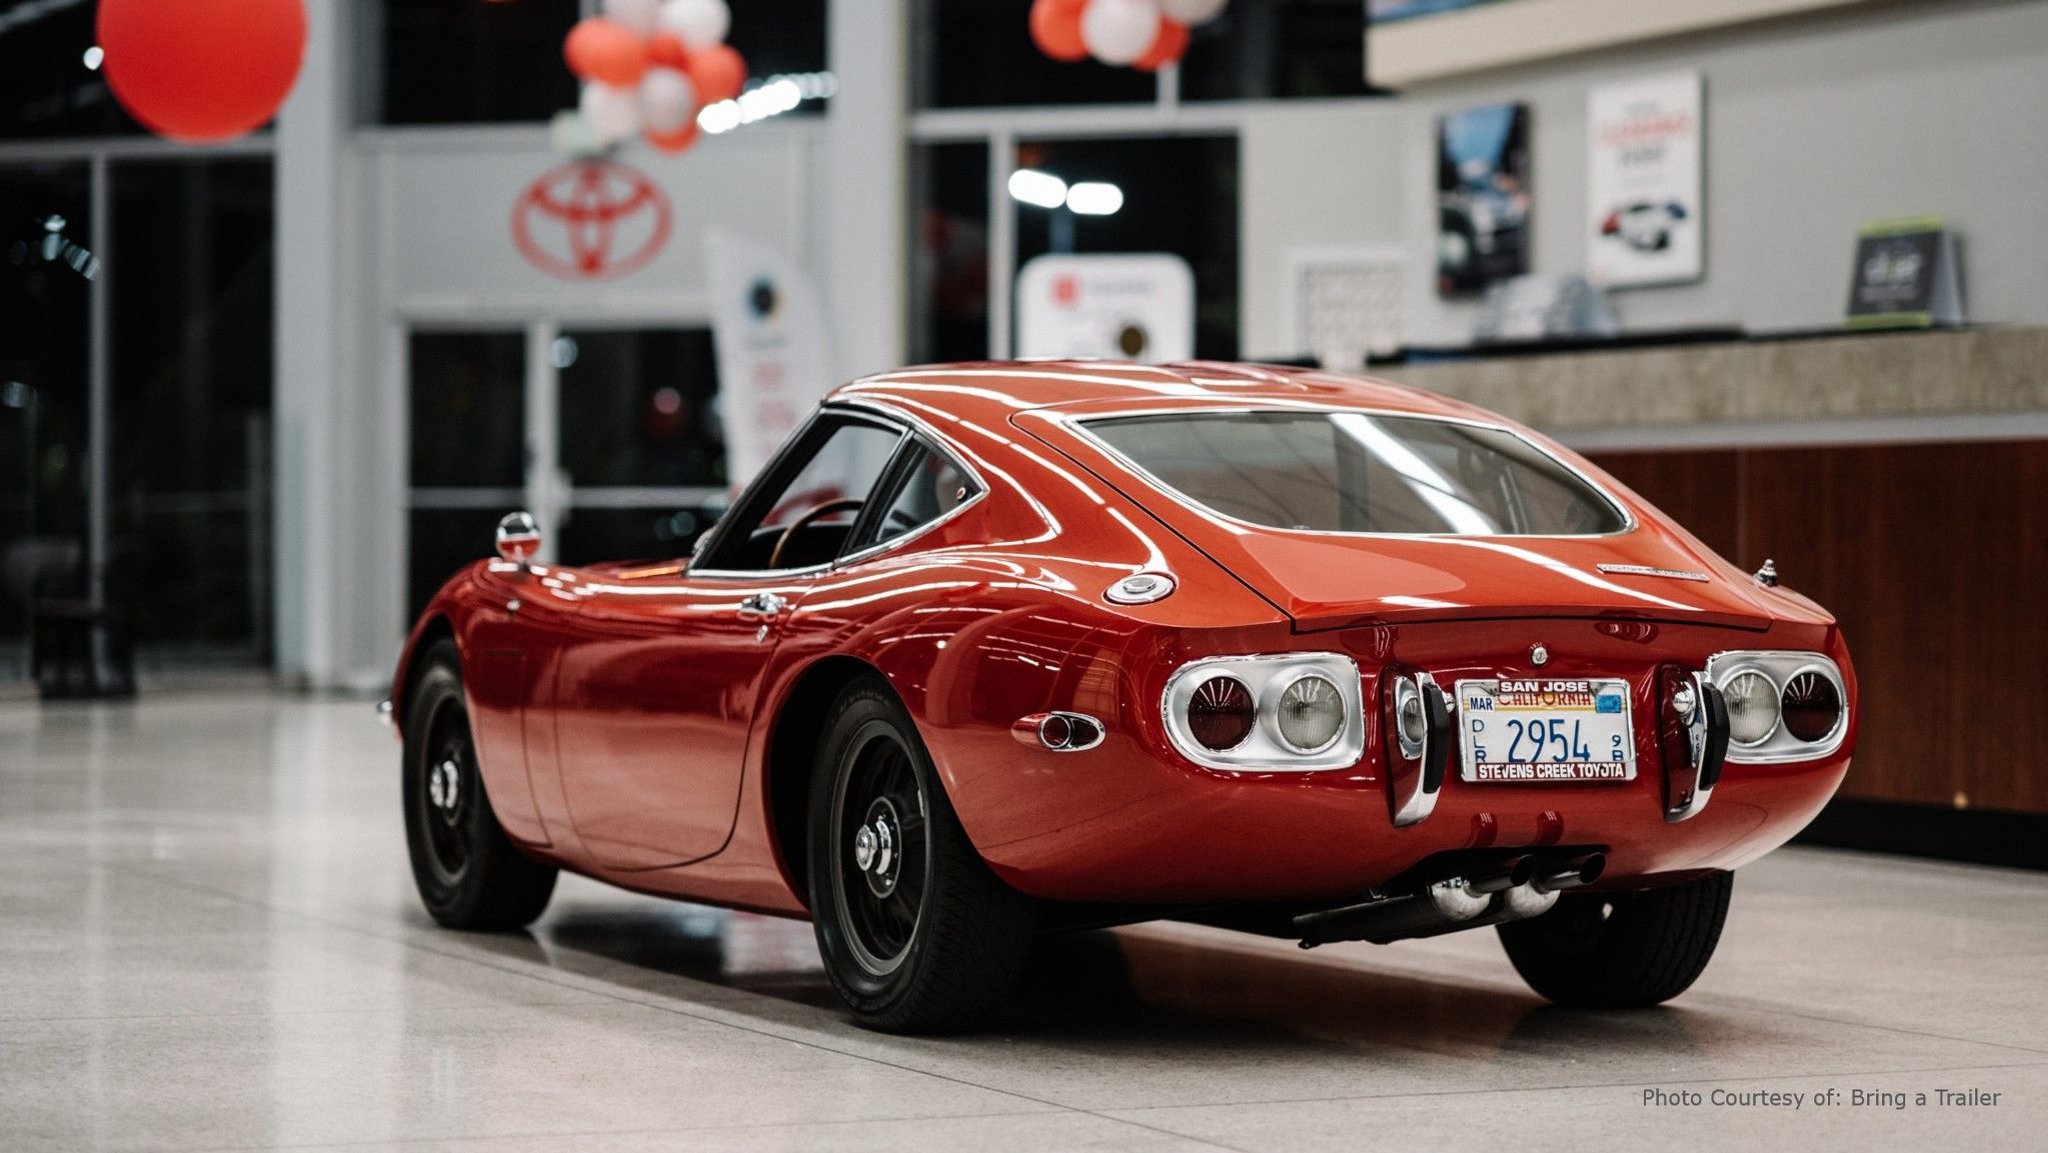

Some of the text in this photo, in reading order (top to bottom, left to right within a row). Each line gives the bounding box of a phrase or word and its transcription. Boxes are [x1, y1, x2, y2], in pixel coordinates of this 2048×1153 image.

[1500, 681, 1588, 692] SAN JOSE
[1470, 697, 1493, 711] MAR
[1507, 719, 1591, 763] 2954
[1479, 763, 1624, 779] STEVENS CREEK TOYOTA
